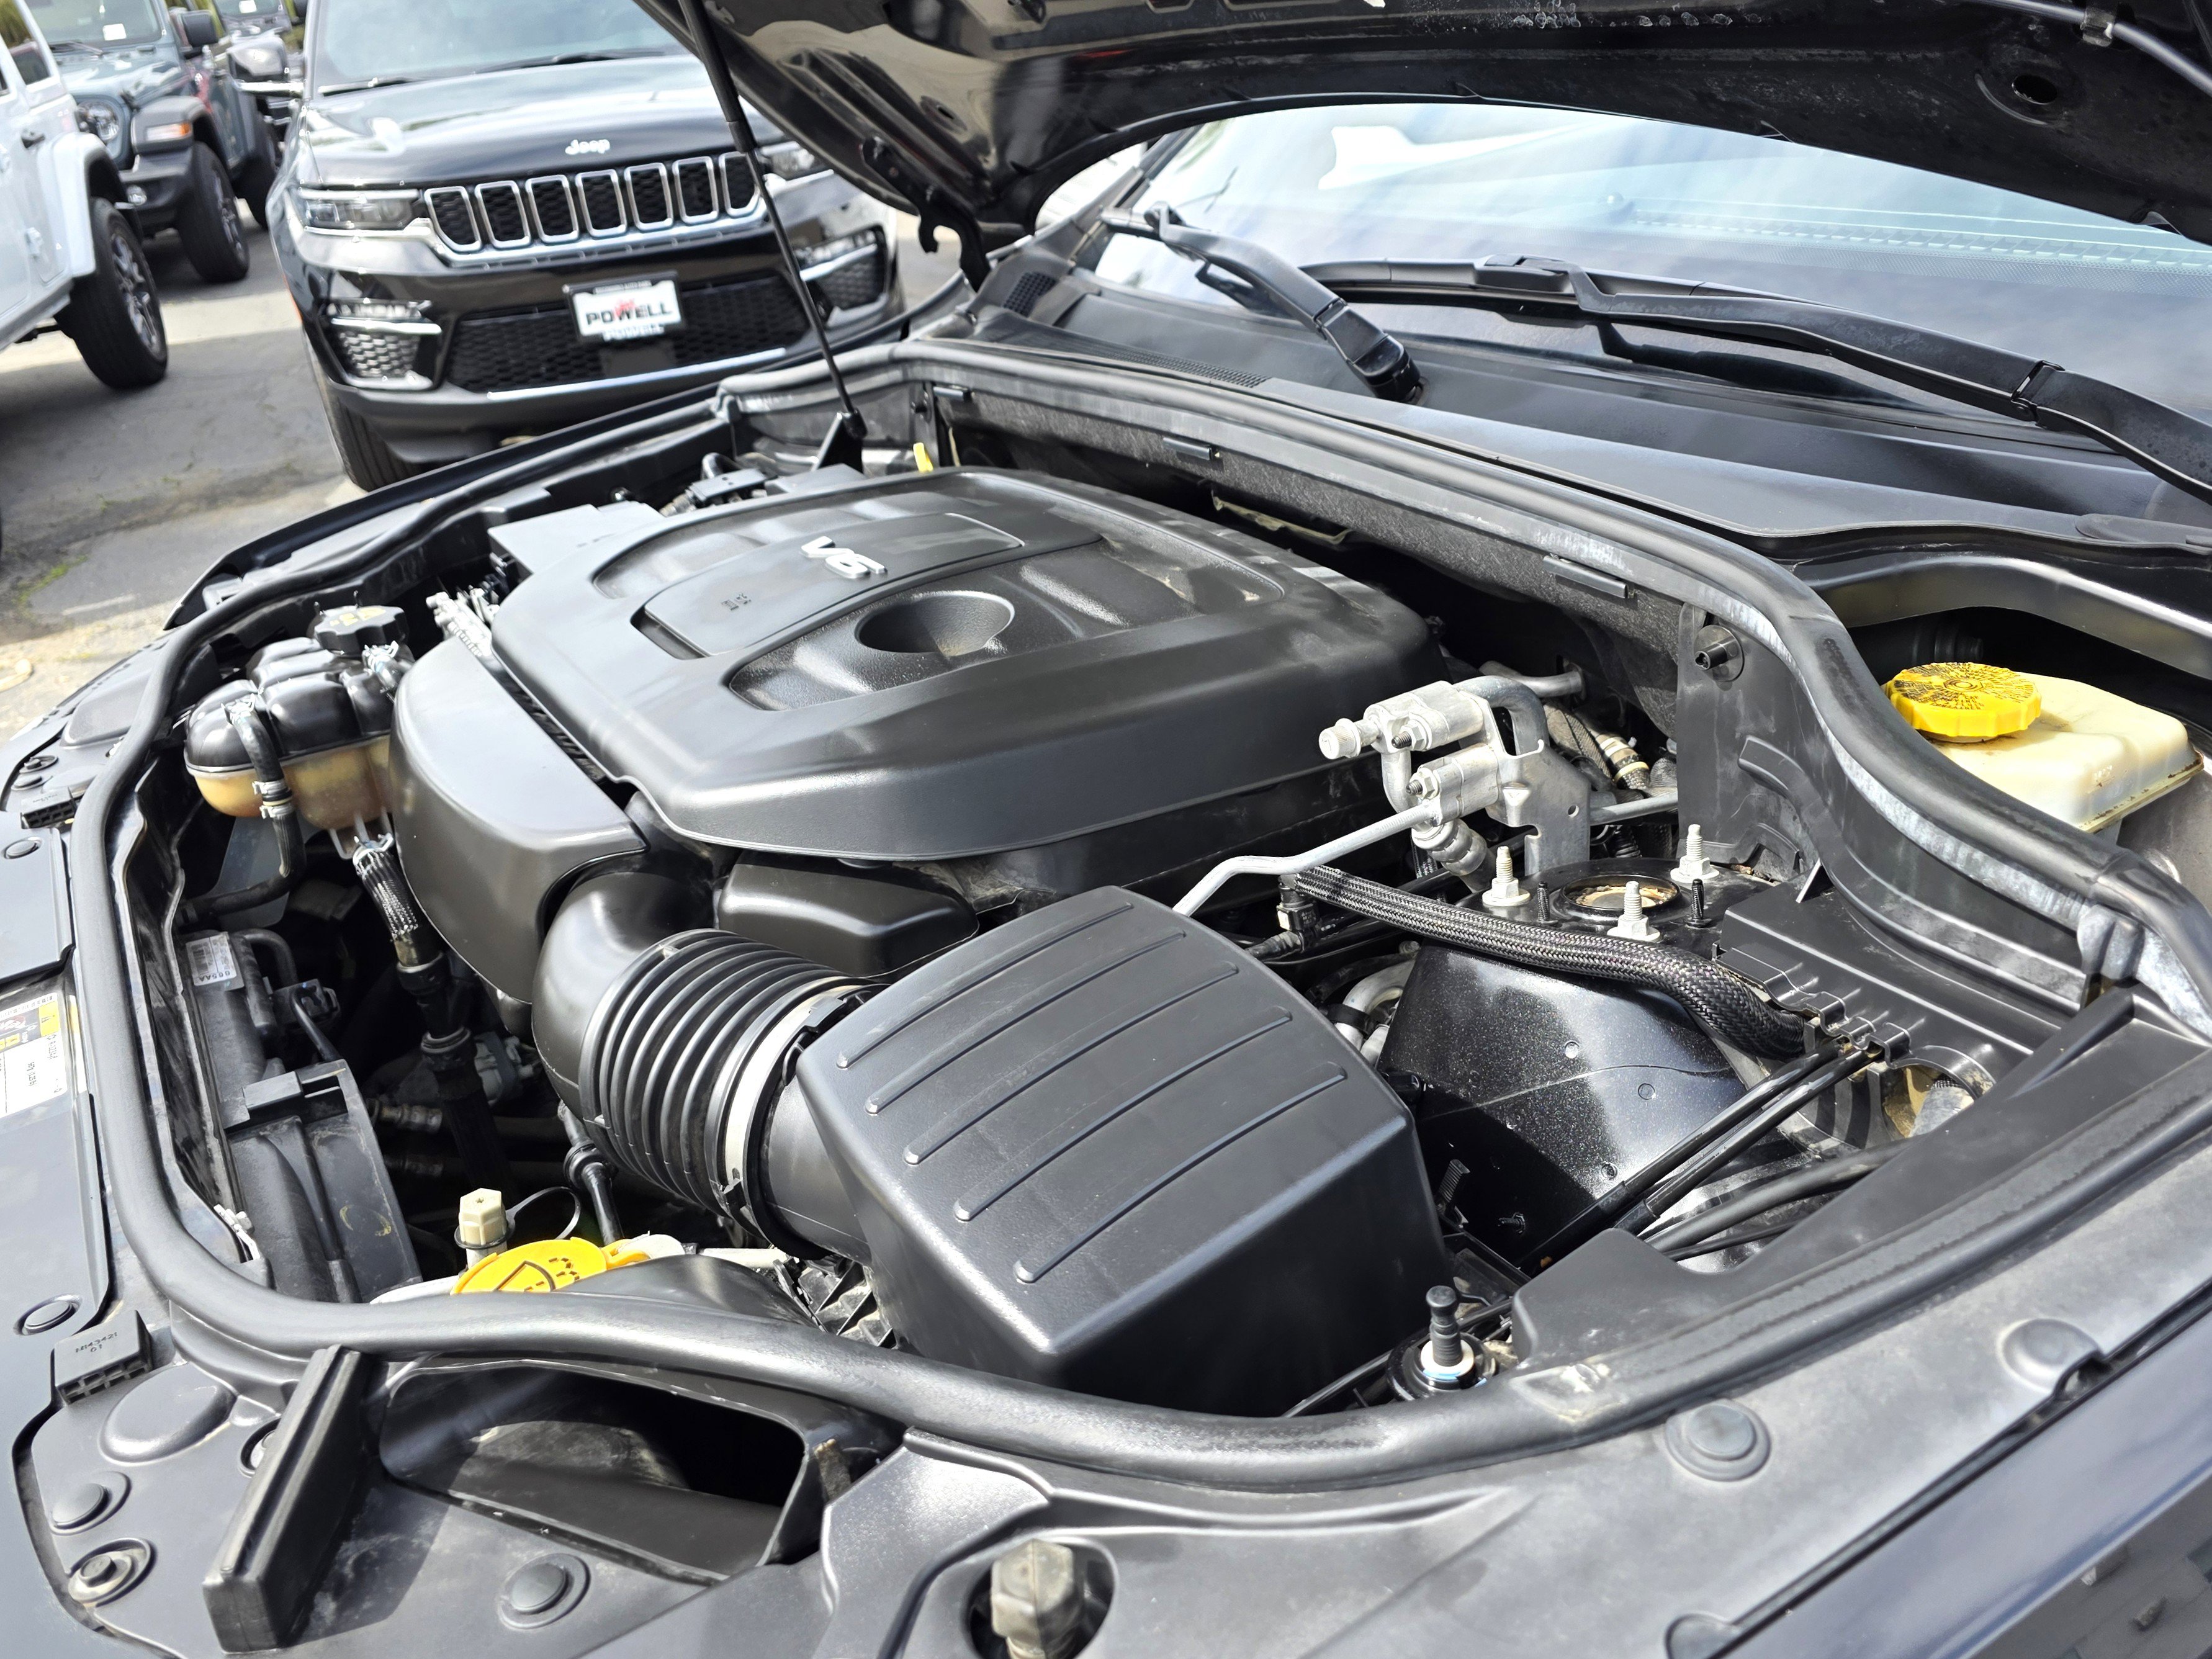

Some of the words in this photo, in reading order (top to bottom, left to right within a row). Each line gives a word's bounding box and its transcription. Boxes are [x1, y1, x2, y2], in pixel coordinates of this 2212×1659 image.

[565, 139, 610, 155] Jeep
[586, 302, 673, 325] POWELL
[801, 536, 886, 578] V6
